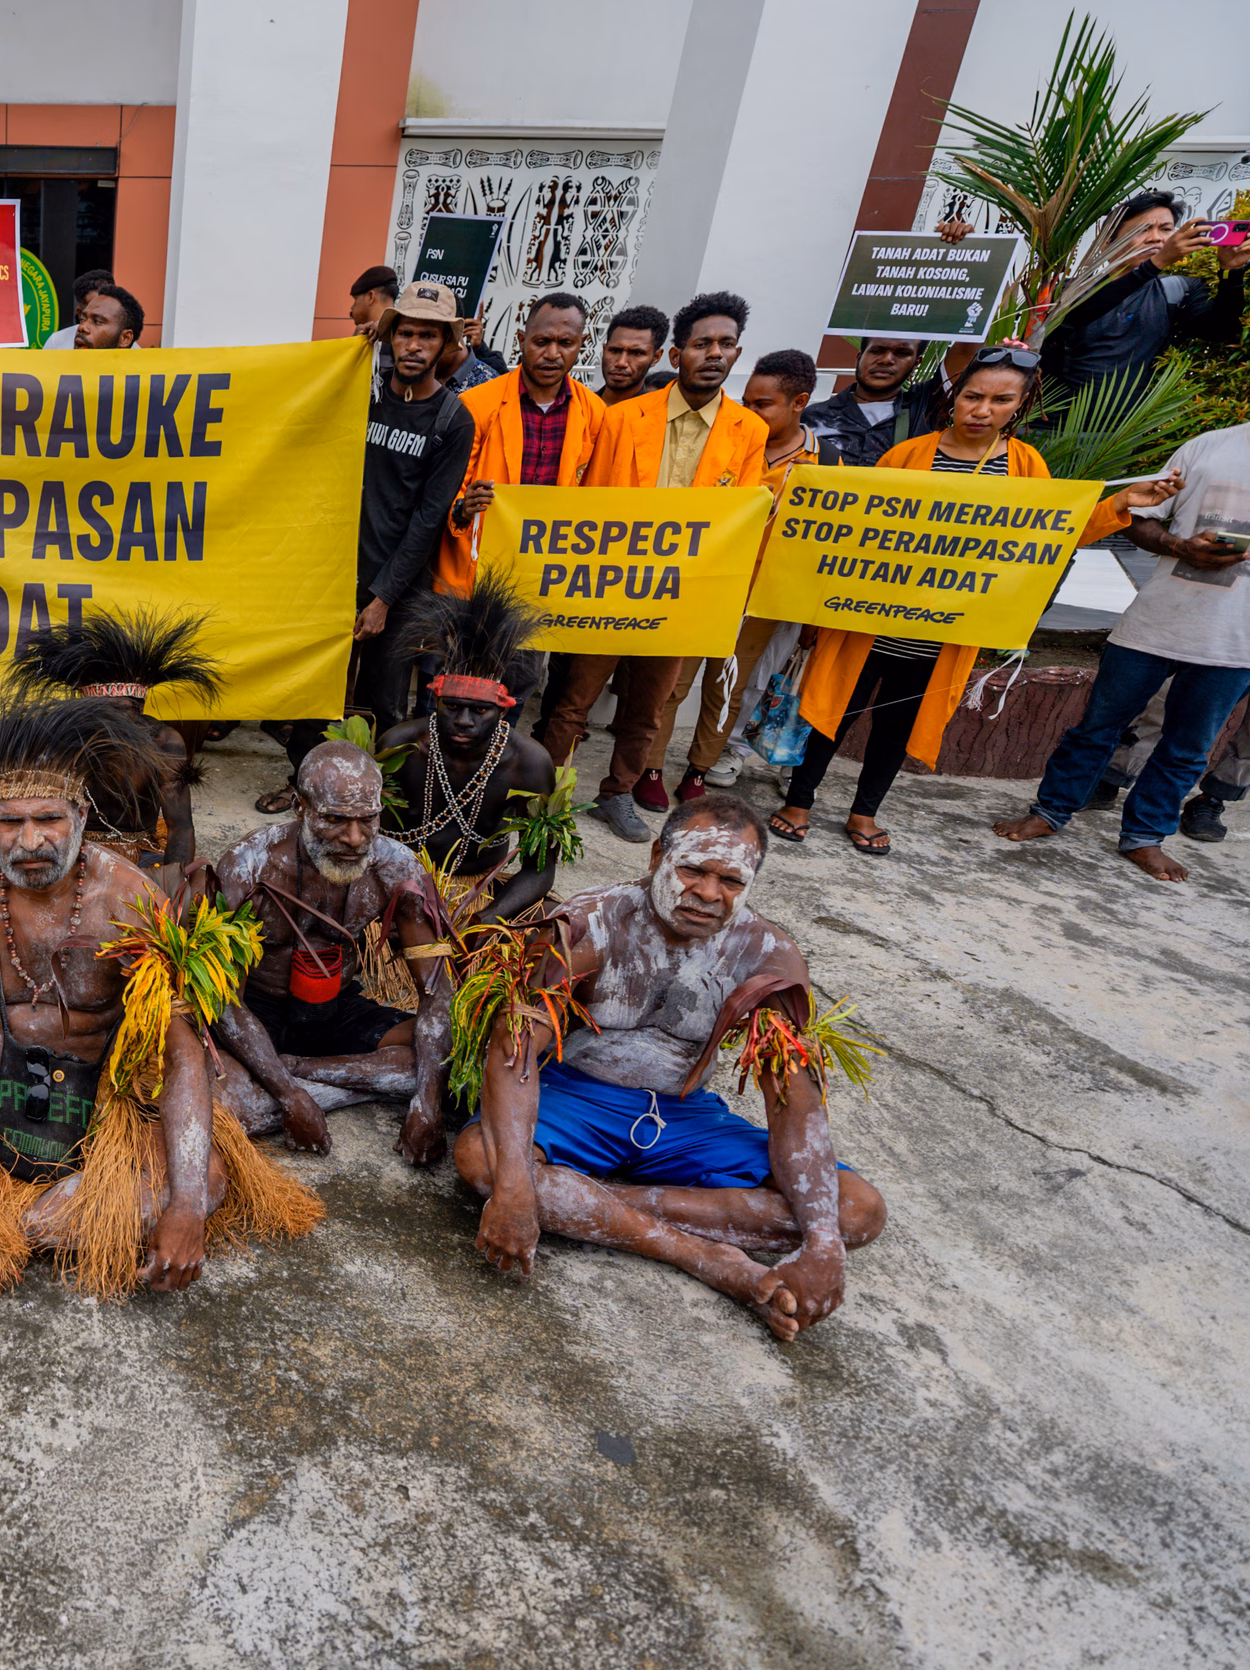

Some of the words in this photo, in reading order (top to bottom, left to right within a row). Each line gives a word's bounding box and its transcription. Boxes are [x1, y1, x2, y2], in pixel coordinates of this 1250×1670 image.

[426, 248, 444, 260] PSN
[871, 247, 914, 260] TANAH
[912, 248, 946, 261] ADAT
[947, 249, 991, 262] BUKAN
[875, 265, 916, 279] TANAH
[916, 267, 970, 283] KOSONG,
[21, 258, 45, 289] NEGARA
[39, 289, 51, 331] JAYAPURA
[852, 283, 894, 297] LAWAN
[895, 286, 985, 300] KOLONIALISME
[890, 303, 929, 317] BARU!
[387, 428, 427, 457] GOFM
[788, 486, 859, 513] STOP
[864, 494, 922, 520] PSN
[927, 500, 1076, 535] MERAUKE,
[519, 519, 711, 557] RESPECT
[781, 518, 853, 544] STOP
[859, 527, 1063, 565] PERAMPASAN
[538, 564, 681, 600] PAPUA
[816, 554, 913, 585] HUTAN
[916, 567, 998, 594] ADAT
[537, 613, 668, 631] GREENPEACE
[823, 596, 965, 624] GREENPEACE
